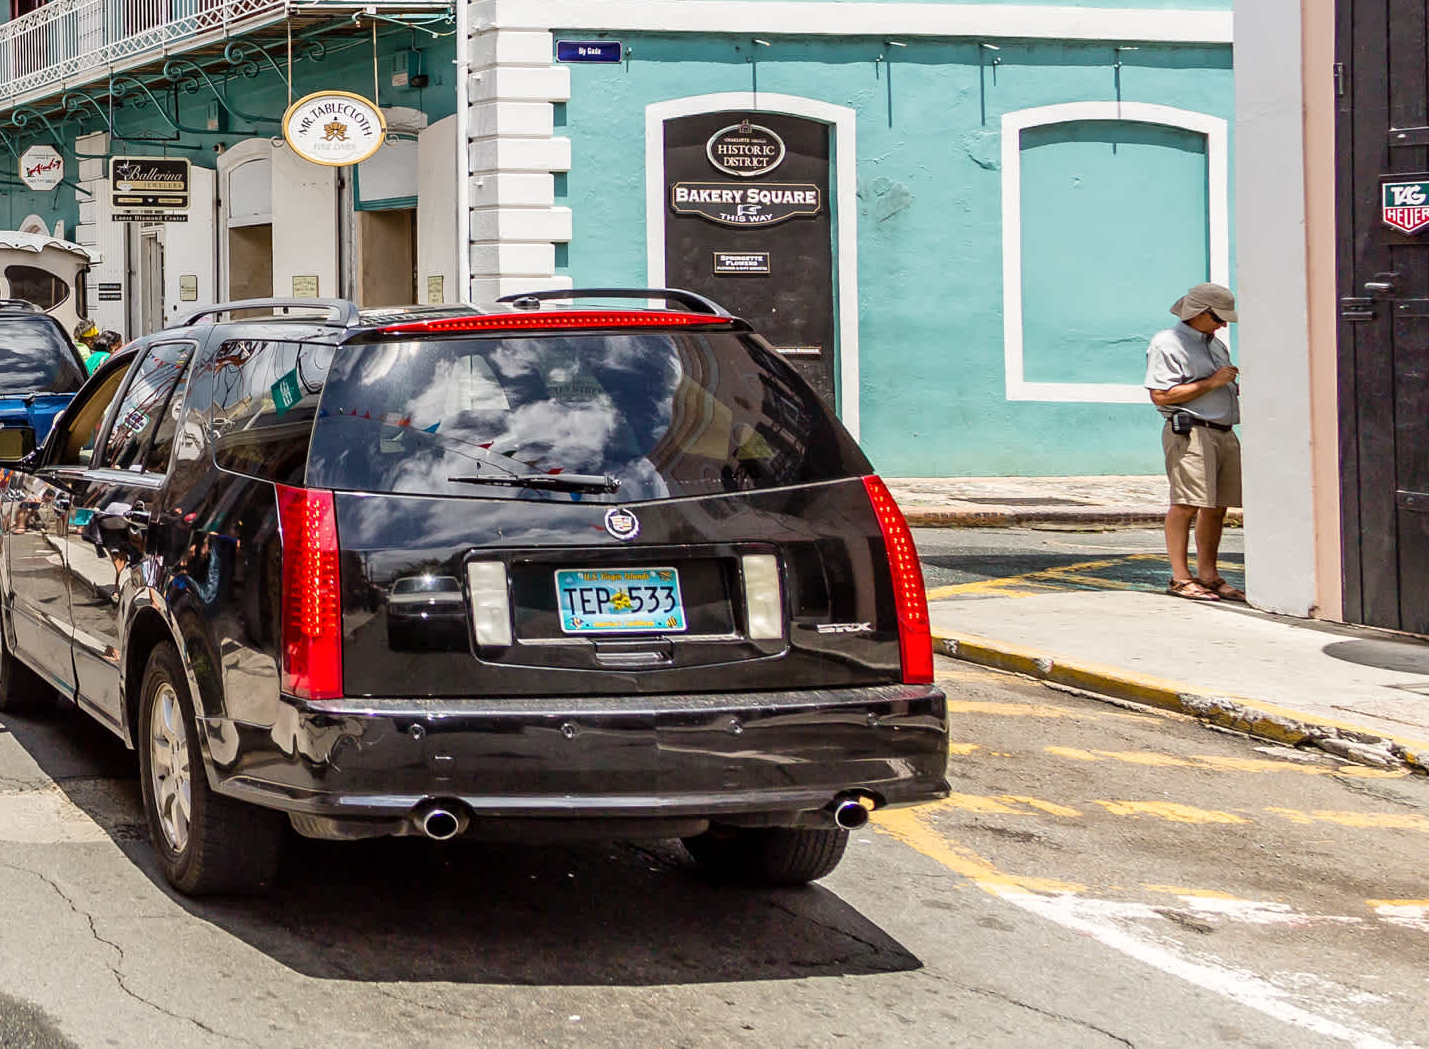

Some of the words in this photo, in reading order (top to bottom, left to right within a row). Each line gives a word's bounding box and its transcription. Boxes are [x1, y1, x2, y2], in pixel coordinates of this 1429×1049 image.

[299, 117, 315, 135] MR.
[310, 102, 372, 136] TABLECLOTH
[718, 145, 775, 155] HISTORIC
[724, 157, 769, 167] DISTRICT
[129, 165, 183, 181] Ballerina
[675, 188, 743, 203] BAKERY
[747, 189, 817, 205] SQUARE
[1390, 185, 1426, 205] TAG
[719, 213, 746, 222] THIS
[750, 214, 773, 222] WAY
[1387, 208, 1429, 228] HEUER
[583, 573, 599, 581] U.S.
[601, 573, 622, 581] Virgin
[624, 572, 649, 580] Islands
[563, 587, 610, 615] TEP
[628, 587, 676, 613] 533
[817, 622, 873, 633] SRX
